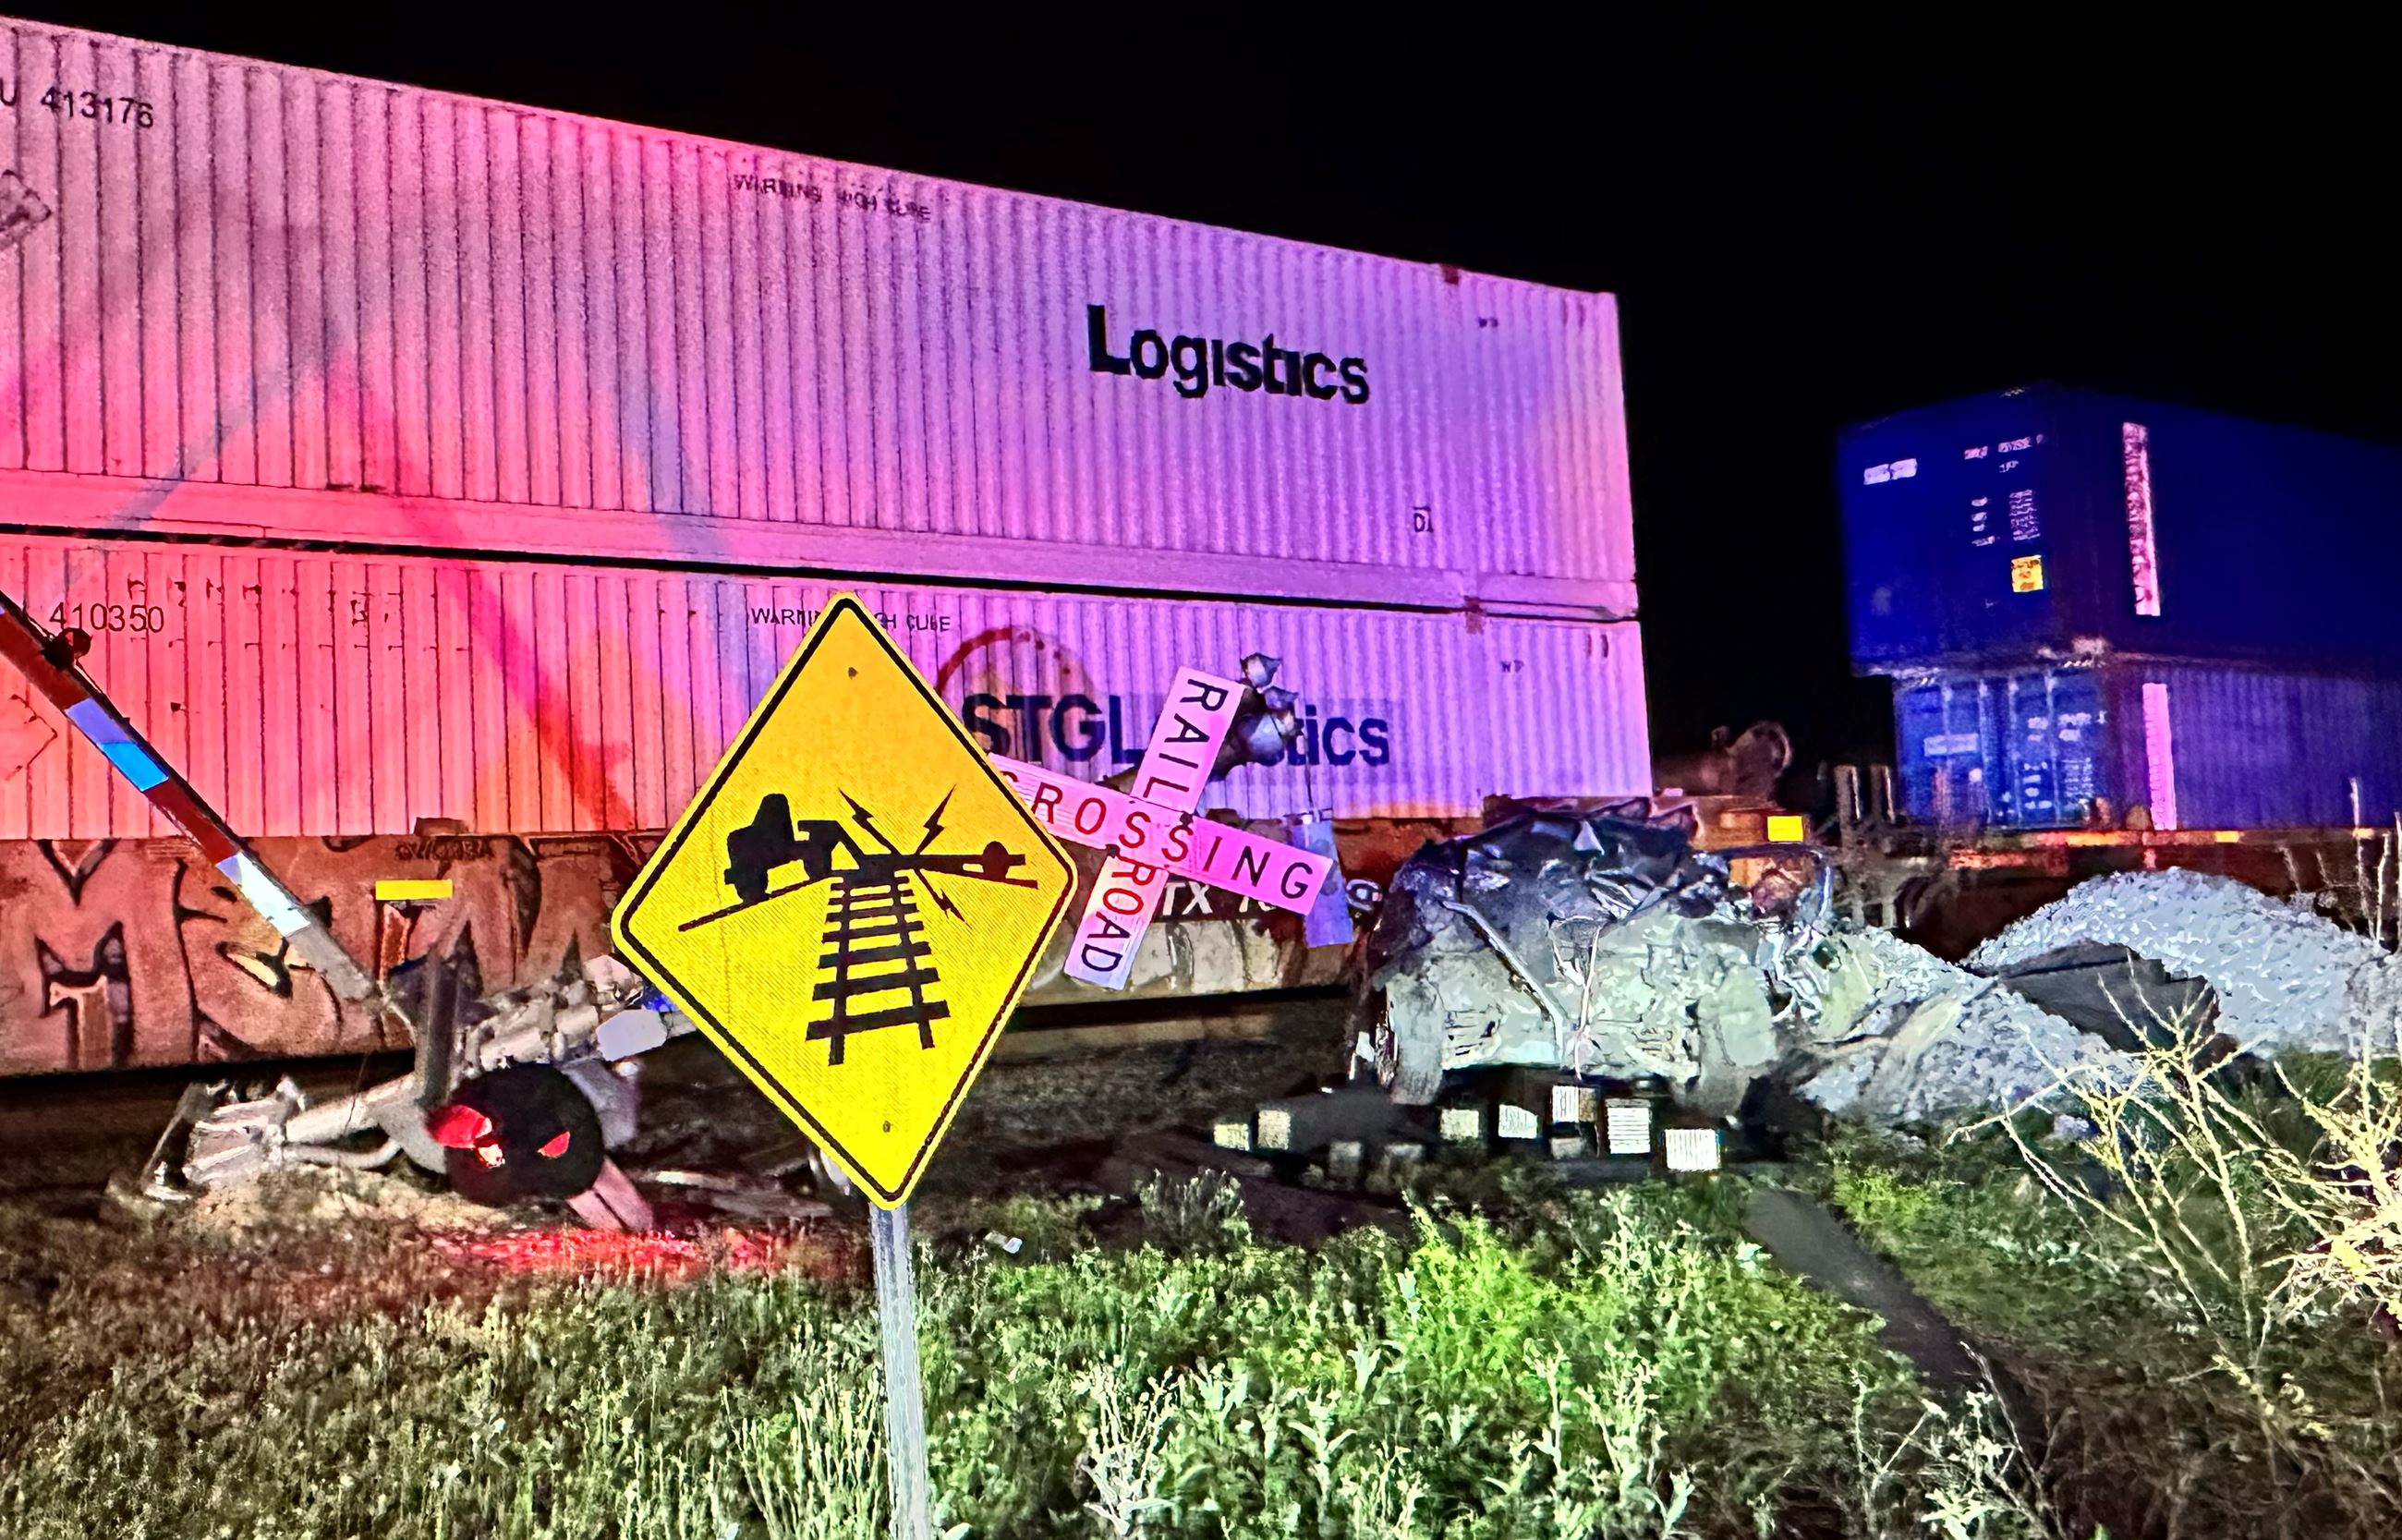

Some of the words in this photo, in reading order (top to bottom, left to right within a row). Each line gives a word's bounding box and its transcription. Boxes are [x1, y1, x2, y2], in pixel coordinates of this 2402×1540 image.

[1086, 304, 1370, 405] Logistics
[49, 601, 164, 633] 410350
[1143, 677, 1228, 798] RAIL
[1082, 855, 1156, 972] ROAD
